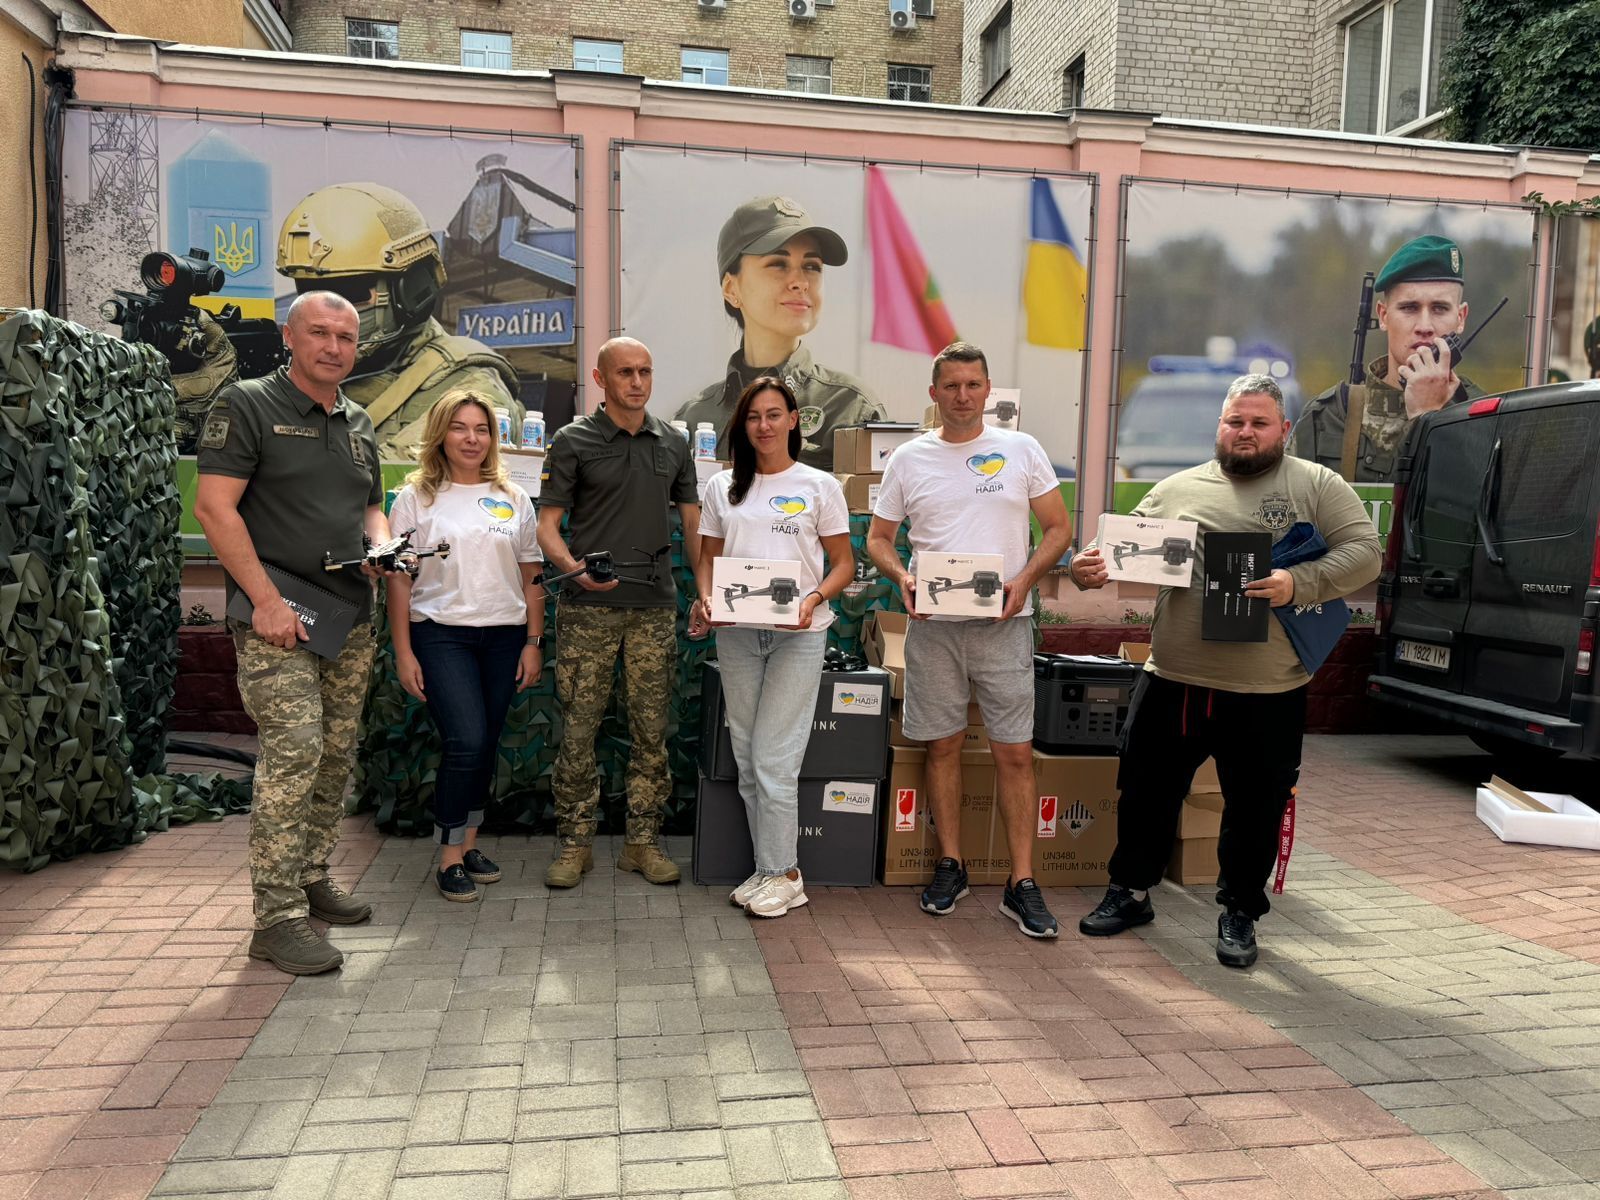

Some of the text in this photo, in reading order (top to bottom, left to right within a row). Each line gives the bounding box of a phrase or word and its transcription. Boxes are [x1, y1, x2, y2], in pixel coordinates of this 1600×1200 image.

[463, 308, 563, 338] Україна
[975, 483, 1004, 494] НАДІЯ
[488, 525, 514, 536] НАДІЯ
[771, 524, 800, 536] НАДІЯ
[1521, 583, 1572, 594] RENAULT
[1401, 642, 1447, 665] AI 1822 IM
[855, 696, 879, 705] НАДІЯ
[846, 795, 870, 804] НАДІЯ
[1282, 814, 1292, 832] FLIGHT
[1281, 836, 1290, 856] BEFORE
[1042, 851, 1076, 860] UN3480
[899, 859, 1011, 868] LITHUM ATTERIES
[1042, 862, 1079, 871] LITHIUM
[1081, 862, 1098, 871] ION
[1277, 859, 1287, 881] REMOVE
